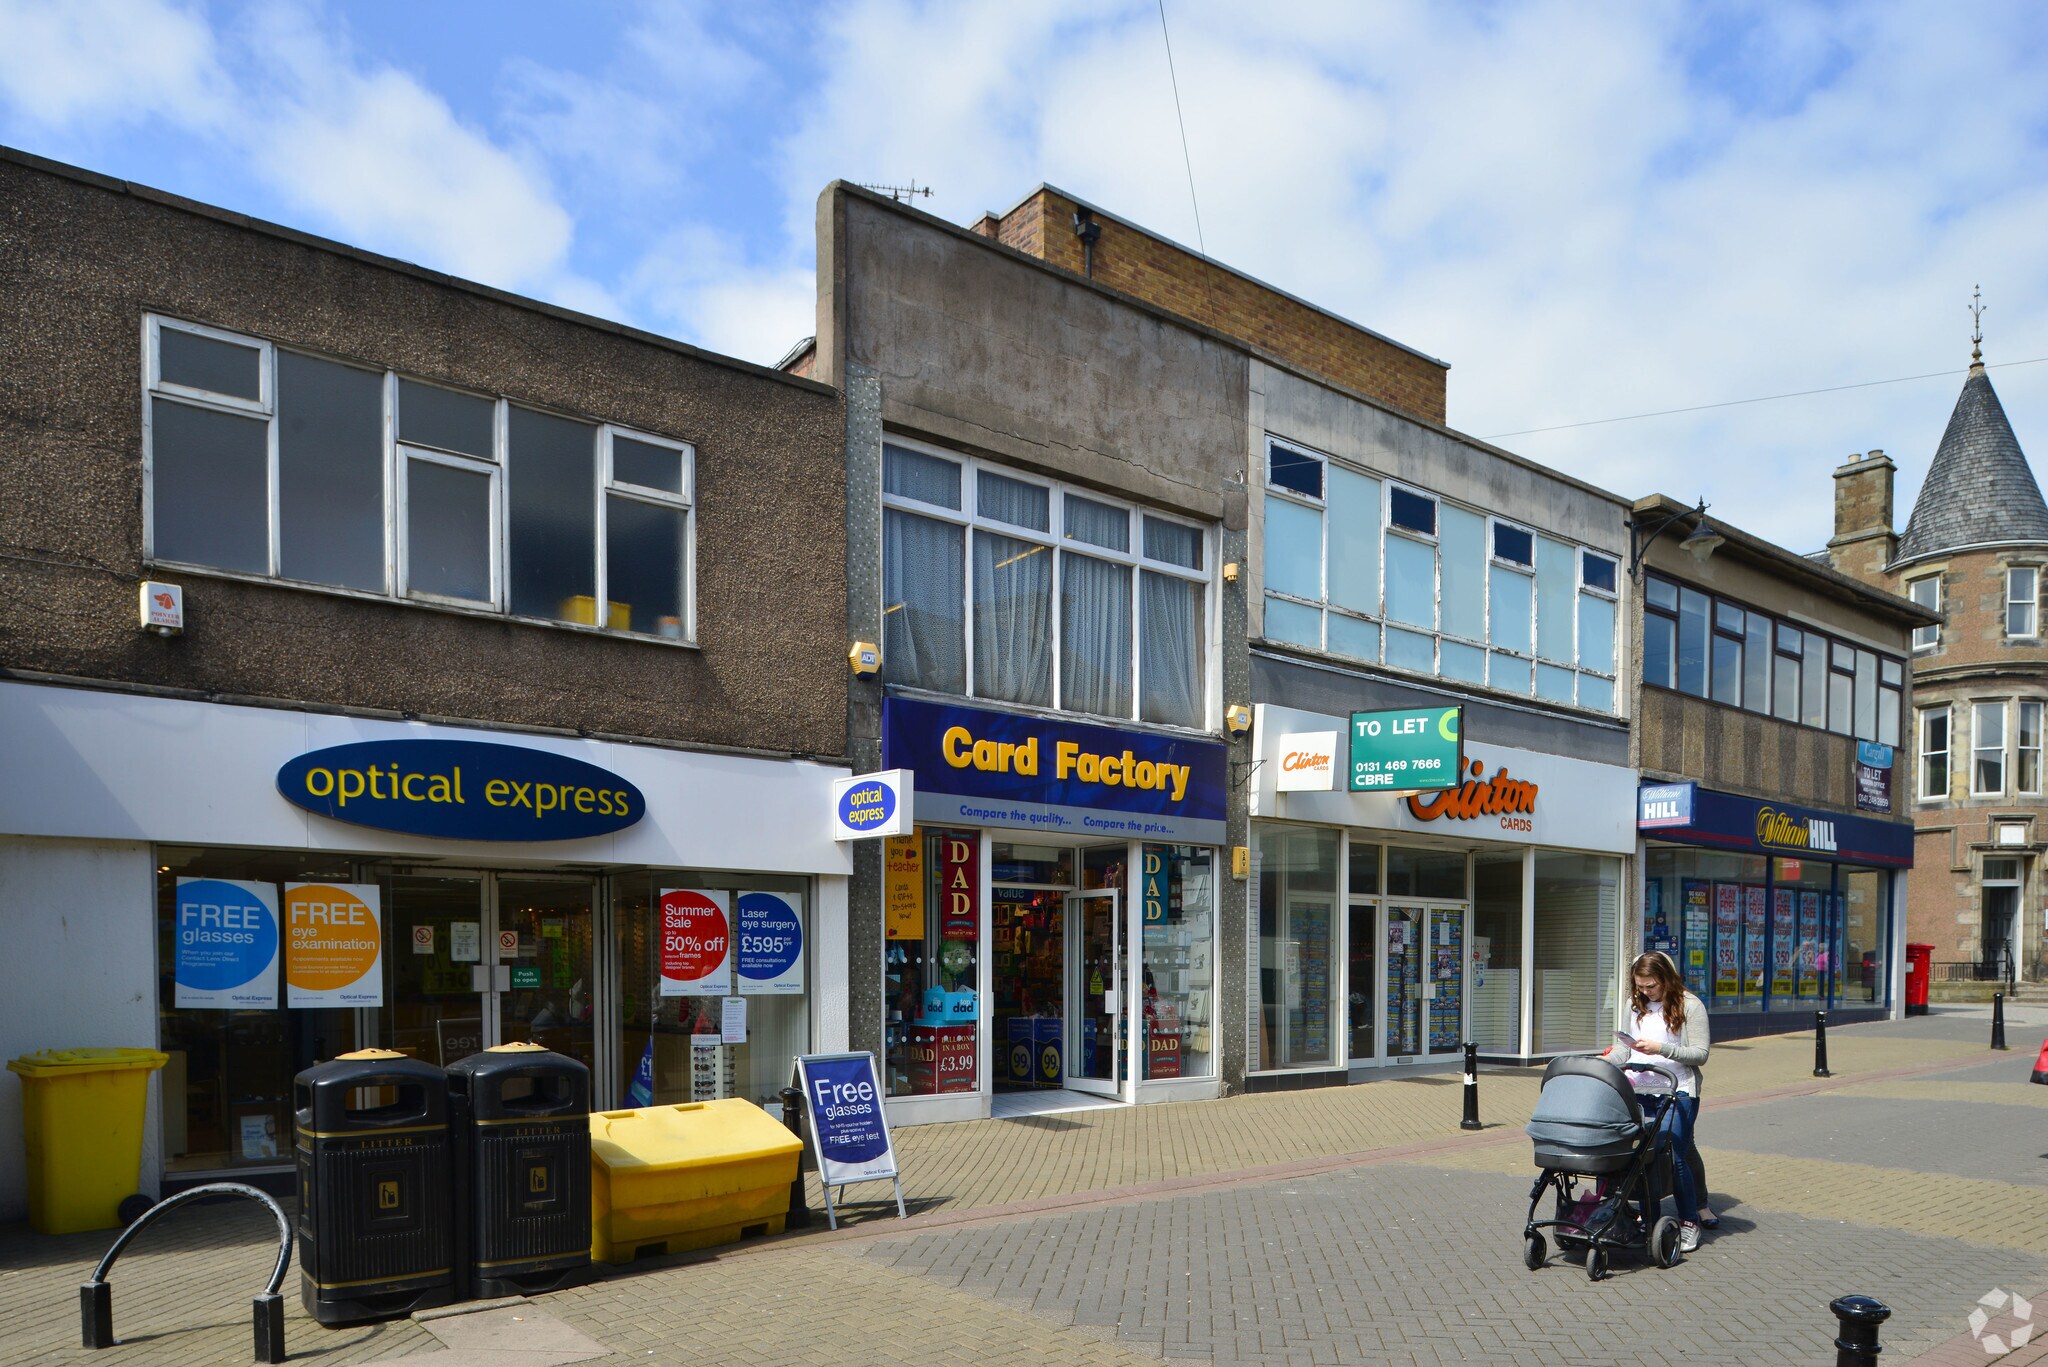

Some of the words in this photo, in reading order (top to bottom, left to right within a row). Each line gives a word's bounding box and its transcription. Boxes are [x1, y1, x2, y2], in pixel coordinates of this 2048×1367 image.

[151, 611, 180, 620] POINTER
[153, 617, 179, 625] ALARMS
[862, 652, 876, 663] ADT
[1356, 720, 1382, 737] TO
[1392, 717, 1429, 735] LET
[942, 726, 1038, 776] Card
[1056, 741, 1191, 802] Factory
[1282, 751, 1330, 772] Clinton
[1355, 761, 1380, 773] 0131
[1384, 760, 1407, 771] 469
[1411, 758, 1441, 770] 7666
[1355, 774, 1394, 786] CBRE
[1863, 766, 1870, 778] TO
[1872, 769, 1882, 781] LET
[305, 762, 466, 807] optical
[484, 777, 630, 819] express
[850, 785, 883, 809] optical
[1642, 787, 1682, 800] William
[848, 806, 885, 826] express
[959, 804, 1008, 823] Compare
[1010, 809, 1028, 822] the
[1030, 812, 1072, 827] quality...
[1644, 801, 1679, 820] HILL
[1082, 815, 1126, 832] Compare
[1128, 819, 1143, 832] the
[1144, 822, 1175, 836] price...
[1500, 816, 1532, 832] CARDS
[1756, 806, 1810, 848] William
[1808, 818, 1838, 851] HILL
[890, 848, 904, 860] you
[886, 861, 920, 872] teacher
[950, 840, 970, 915] DAD
[1145, 854, 1162, 920] DAD
[1720, 888, 1736, 900] PLAY
[1720, 900, 1736, 913] FREE
[1803, 896, 1817, 907] PLAY
[291, 902, 366, 926] FREE
[664, 904, 716, 916] Summer
[742, 908, 768, 918] Laser
[1748, 902, 1764, 916] FREE
[1776, 904, 1791, 916] FREE
[1802, 907, 1817, 918] FREE
[182, 903, 260, 930] FREE
[664, 916, 692, 928] Sale
[742, 920, 759, 930] eye
[761, 920, 797, 931] surgery
[182, 928, 254, 945] glasses
[292, 927, 318, 940] eye
[292, 938, 376, 950] examination
[665, 936, 702, 952] 50%
[704, 936, 725, 952] off
[742, 936, 784, 953] £595
[1720, 950, 1735, 962] £50
[1748, 950, 1763, 963] £50
[1776, 950, 1790, 963] £50
[927, 1002, 943, 1012] dad
[953, 1002, 974, 1013] dad
[941, 1035, 971, 1043] BLLON
[1152, 1038, 1178, 1052] DAD
[911, 1046, 935, 1062] DAD
[940, 1055, 974, 1072] £3.99
[814, 1078, 873, 1106] Free
[826, 1103, 872, 1121] glasses
[516, 1126, 561, 1136] LITTER
[360, 1137, 413, 1149] LITTER
[829, 1135, 851, 1144] FREE
[852, 1134, 865, 1143] eye
[866, 1132, 880, 1141] test
